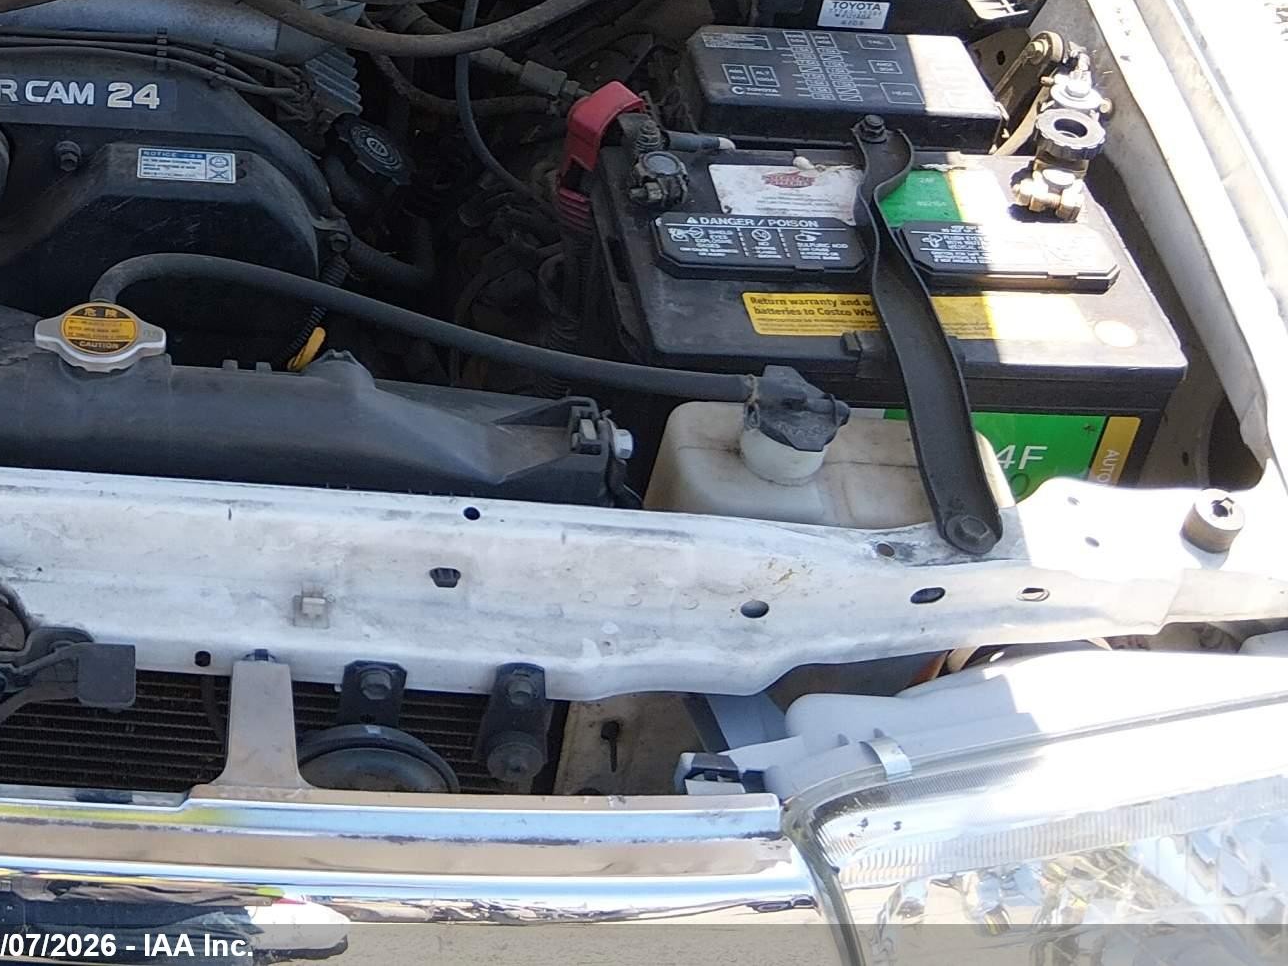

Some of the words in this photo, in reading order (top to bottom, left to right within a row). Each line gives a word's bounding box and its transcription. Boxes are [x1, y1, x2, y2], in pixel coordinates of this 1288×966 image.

[832, 1, 881, 11] TOYOTA
[25, 80, 95, 106] CAM
[107, 82, 160, 110] 24
[699, 216, 755, 226] DANGER
[768, 219, 819, 228] POISON
[750, 297, 787, 306] Return
[789, 299, 837, 307] warranty
[754, 307, 802, 316] batteries
[817, 308, 852, 317] Costco
[79, 340, 120, 349] CAUTION
